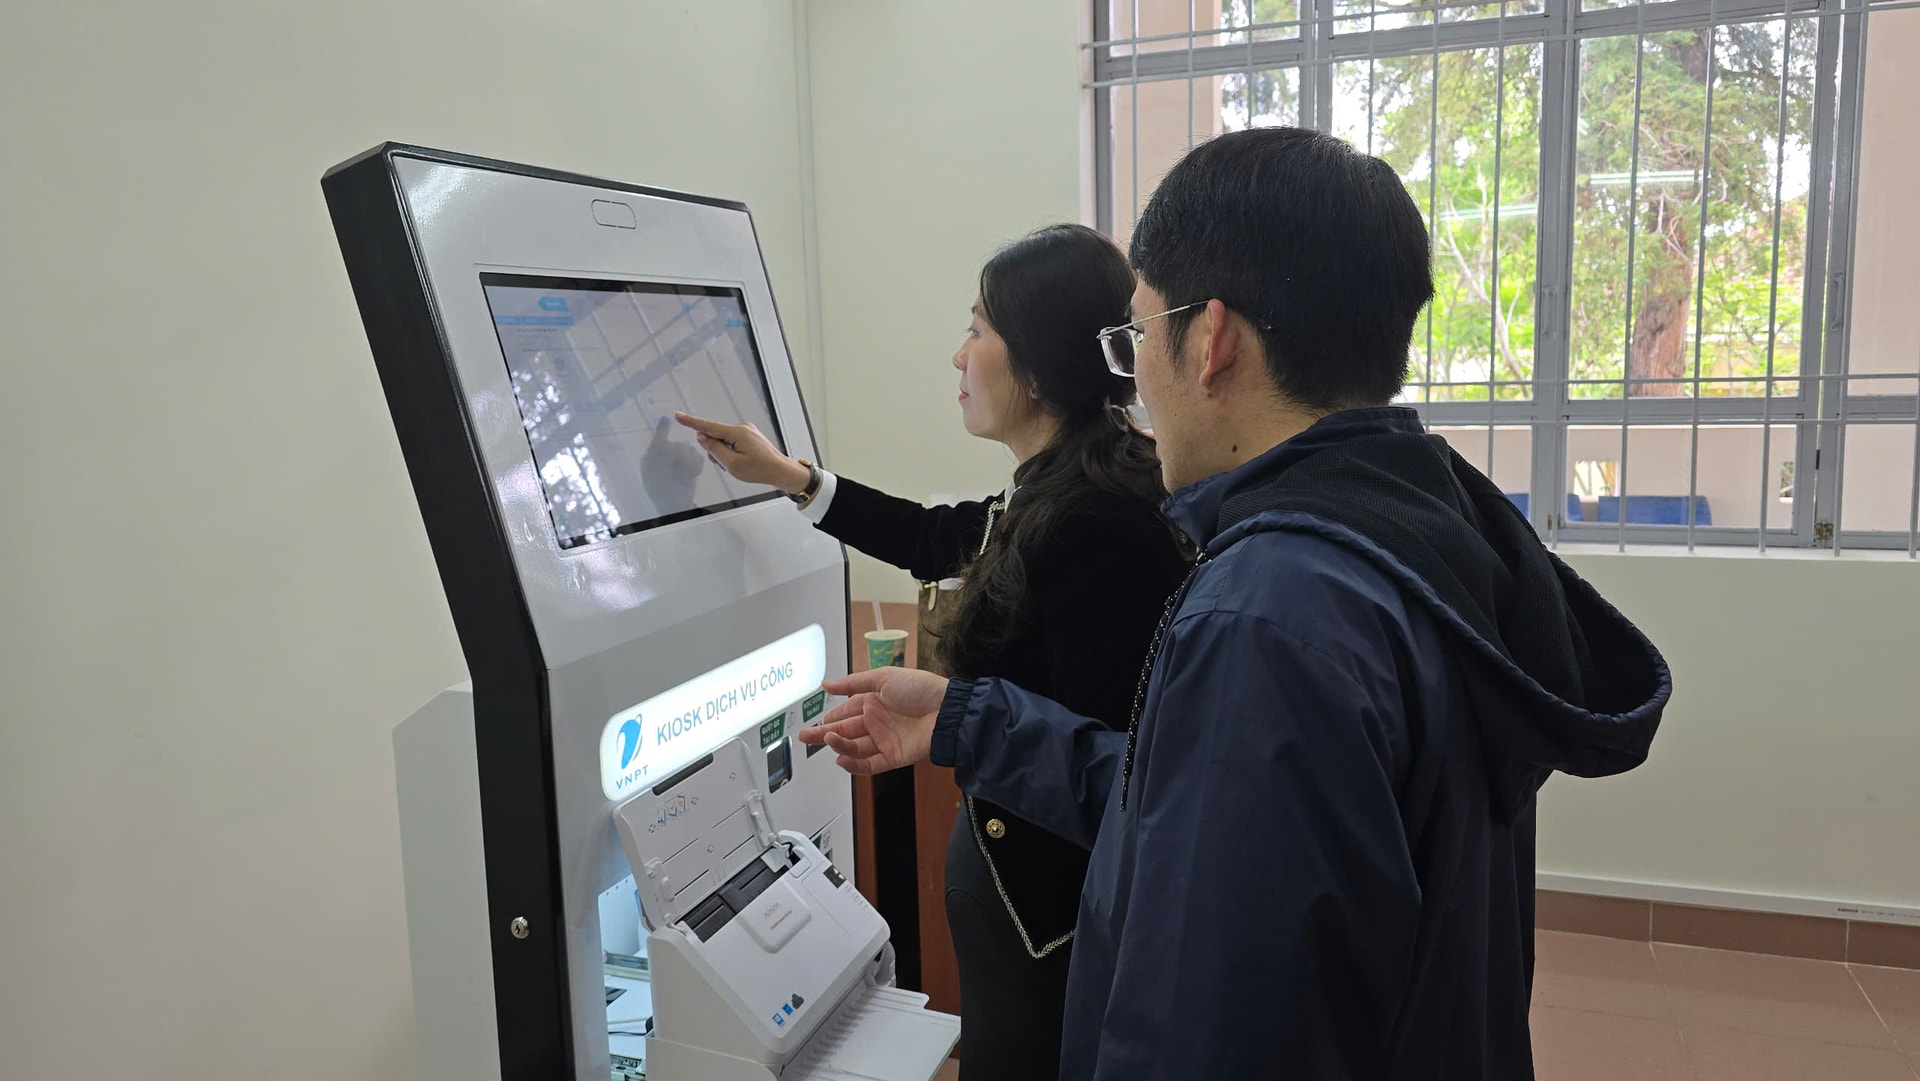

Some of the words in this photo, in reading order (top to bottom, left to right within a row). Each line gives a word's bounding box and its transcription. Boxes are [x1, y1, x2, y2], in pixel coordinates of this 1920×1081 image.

[657, 706, 702, 746] KIOSK
[706, 688, 737, 720] DỊCH
[741, 679, 757, 701] VỤ
[760, 661, 793, 691] CÔNG
[616, 764, 649, 789] VNPT
